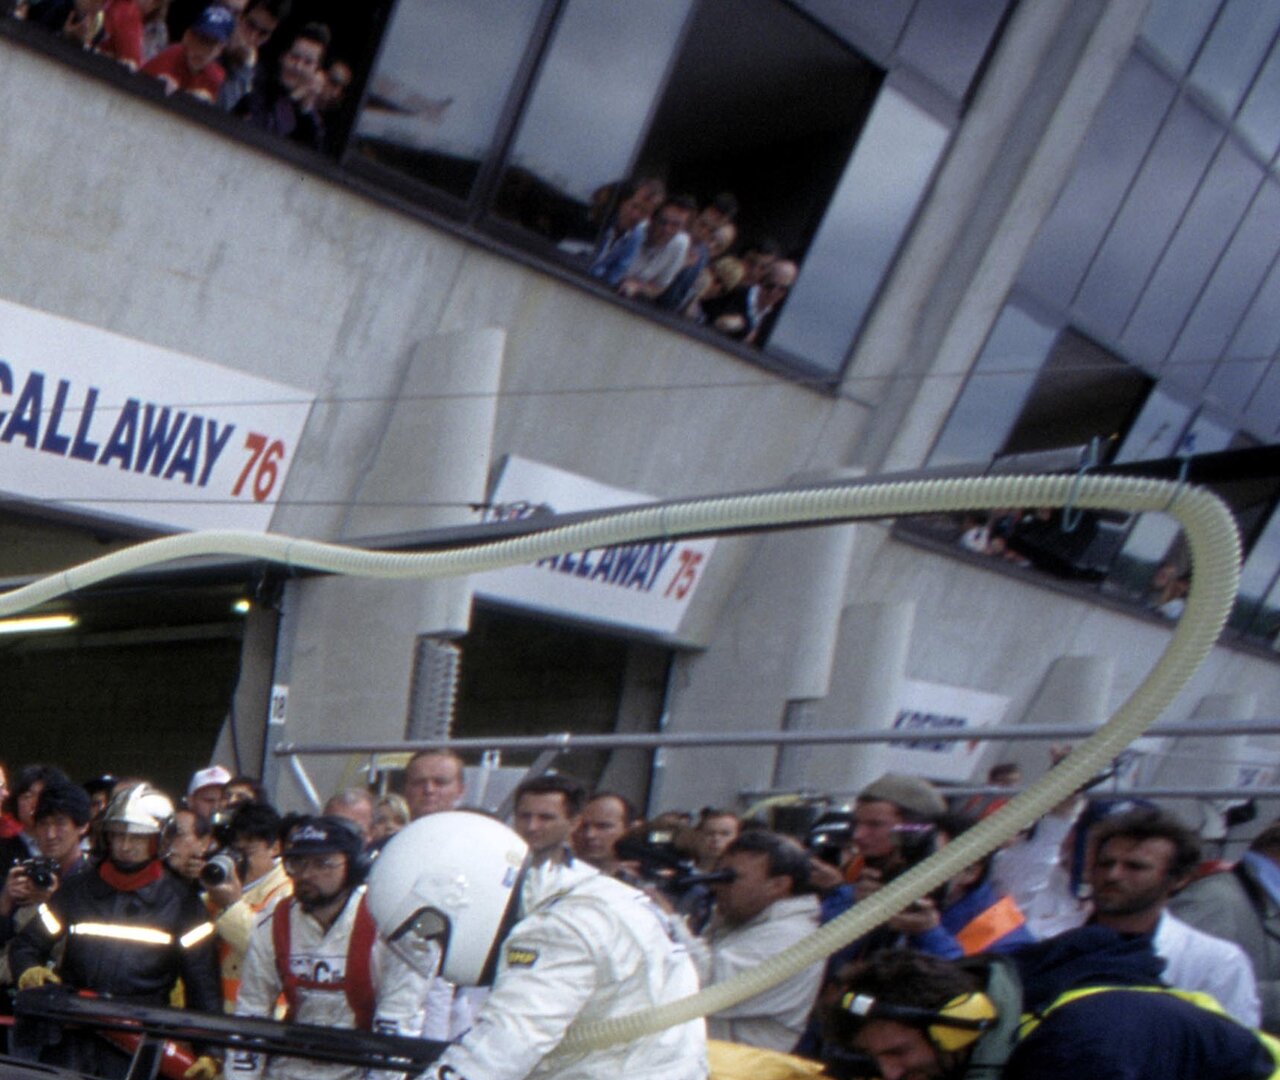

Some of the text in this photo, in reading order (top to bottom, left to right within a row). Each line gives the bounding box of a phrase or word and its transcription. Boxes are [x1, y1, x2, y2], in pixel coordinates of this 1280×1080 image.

[231, 431, 285, 503] 76
[536, 541, 703, 600] LAWAY 75
